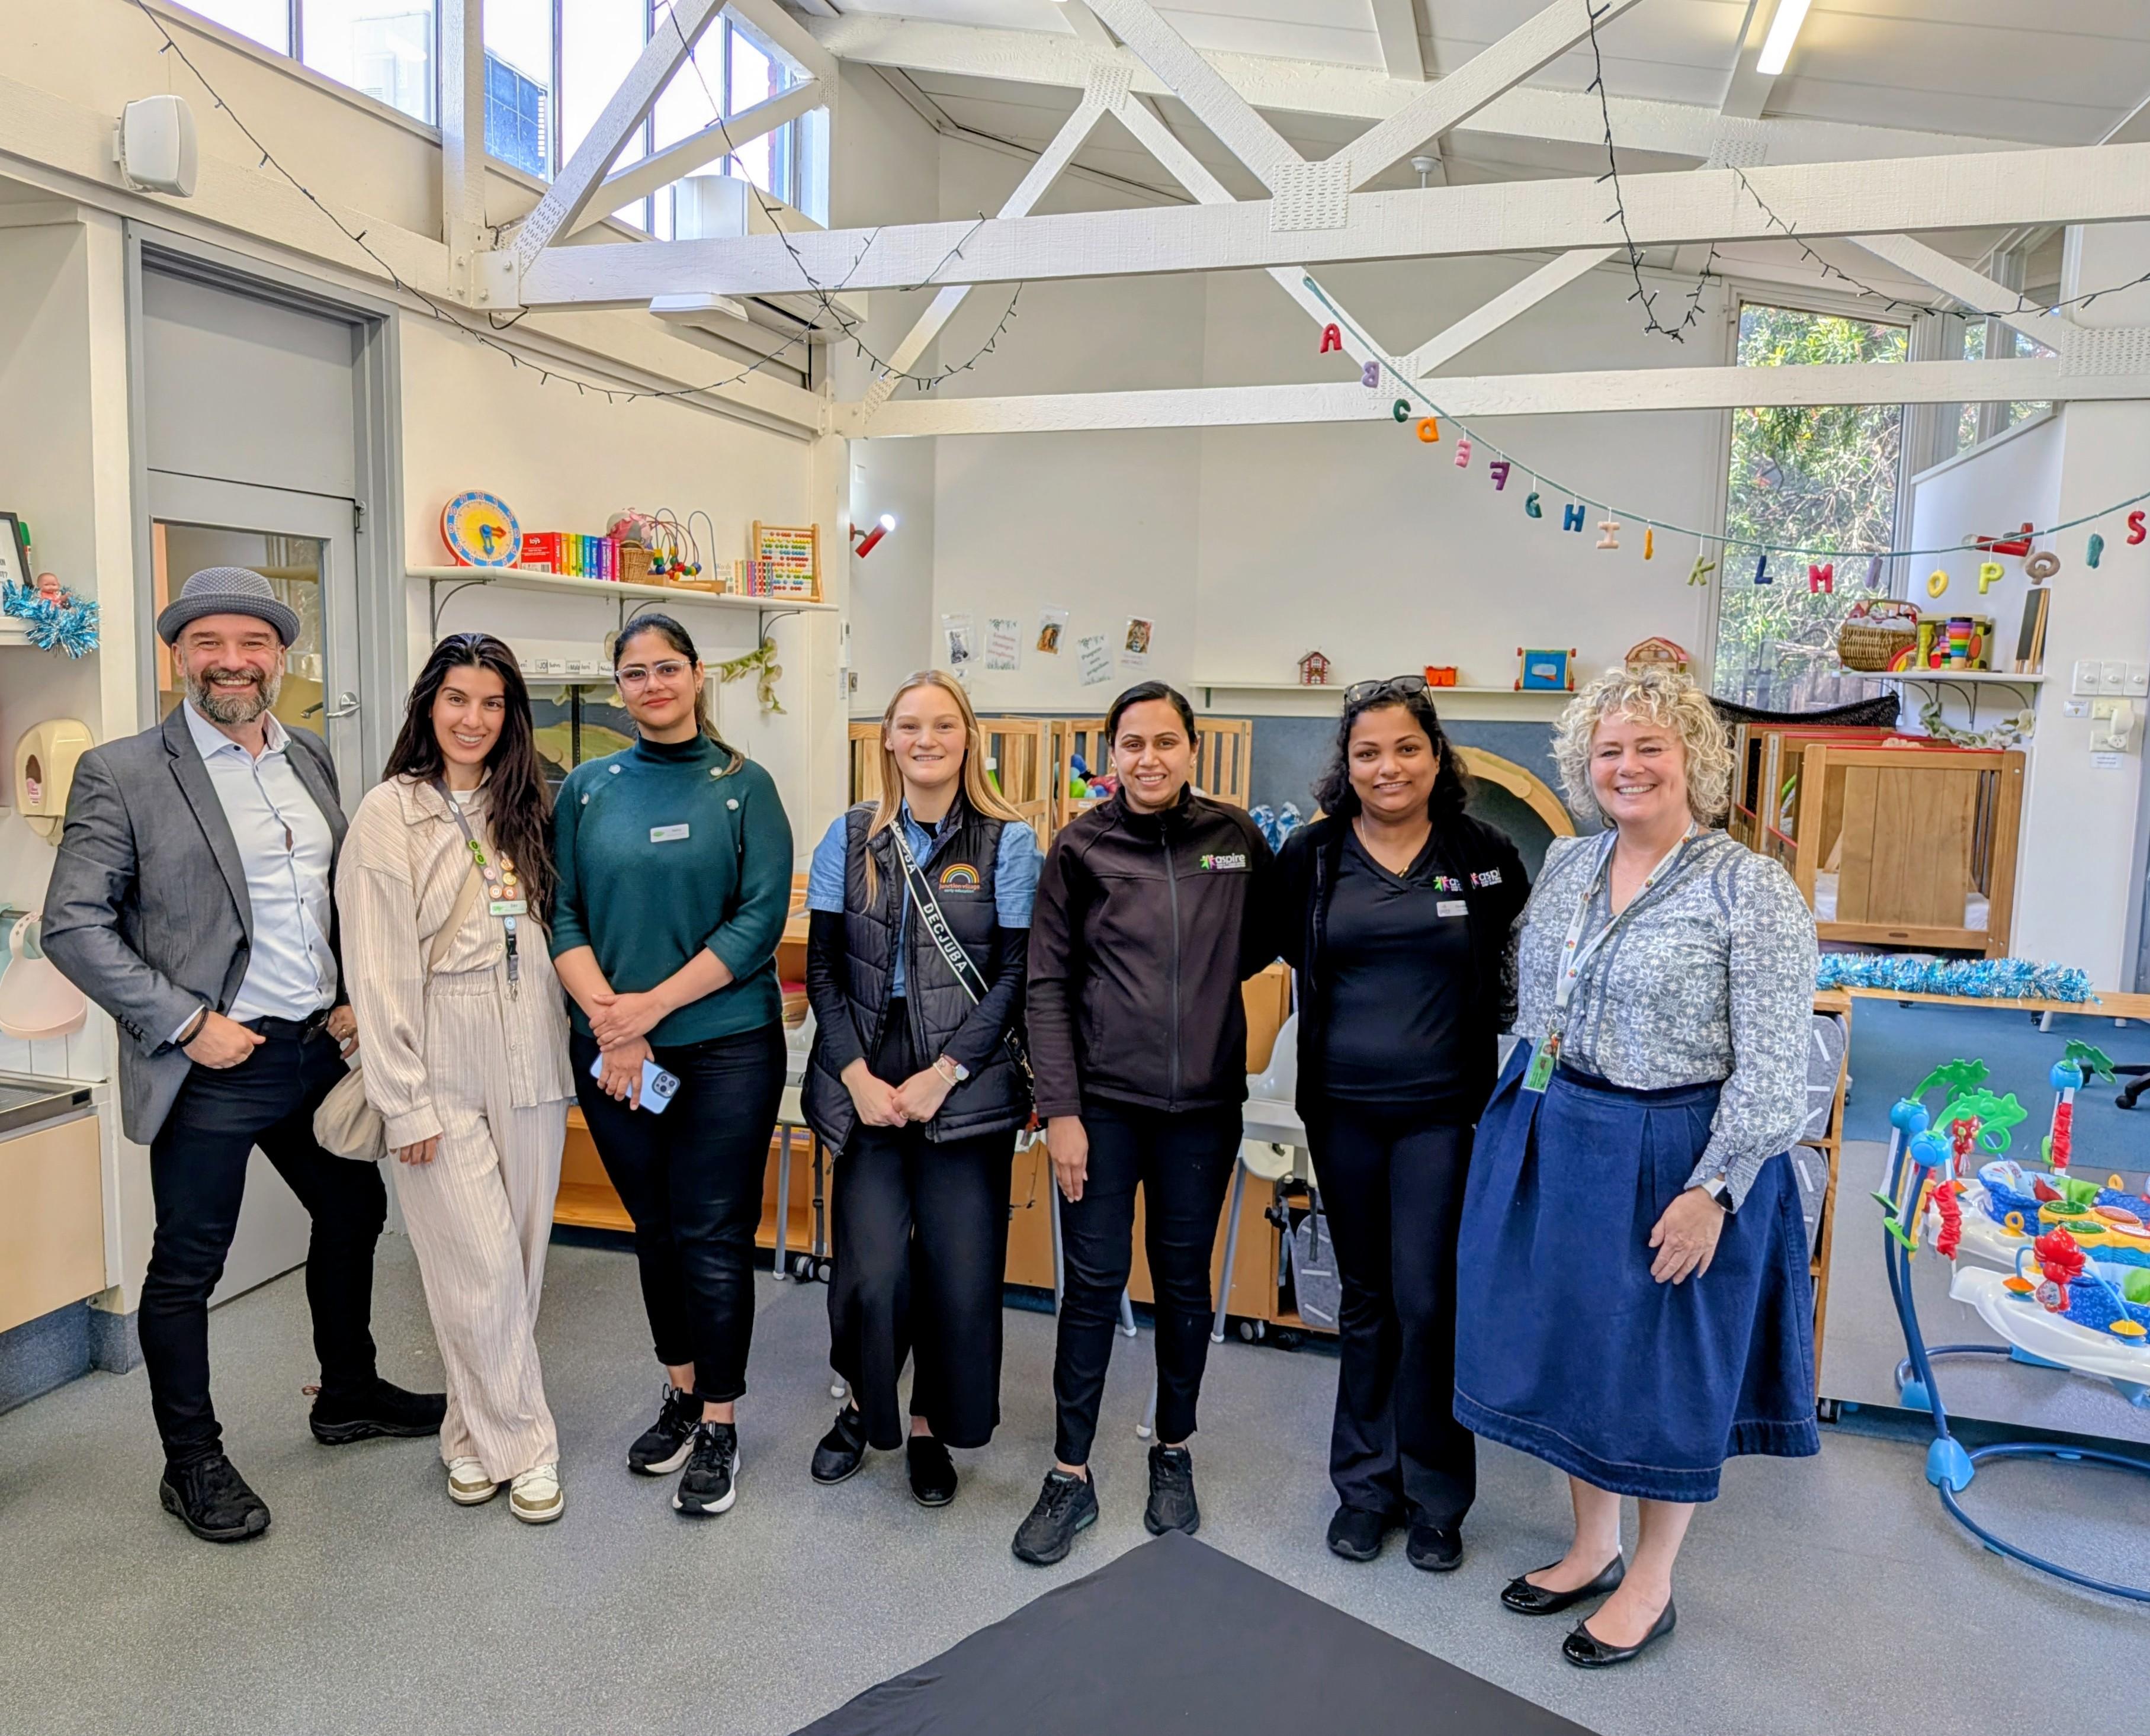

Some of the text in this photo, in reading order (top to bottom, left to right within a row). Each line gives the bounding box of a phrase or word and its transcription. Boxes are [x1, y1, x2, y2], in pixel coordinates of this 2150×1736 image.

[1320, 323, 1342, 353] A
[1393, 398, 1411, 423] C
[1563, 503, 1586, 532] H
[1596, 521, 1620, 549] I
[1686, 554, 1716, 586] K
[1754, 554, 1773, 585] L
[1808, 563, 1833, 593] M
[1927, 570, 1949, 599] O
[1978, 562, 2005, 595] P
[2024, 551, 2061, 586] Q
[2126, 511, 2146, 545] S
[474, 492, 484, 500] 12
[448, 506, 457, 515] 10
[529, 537, 541, 545] toys
[1215, 853, 1246, 864] aspire
[923, 903, 967, 973] DECJUBA
